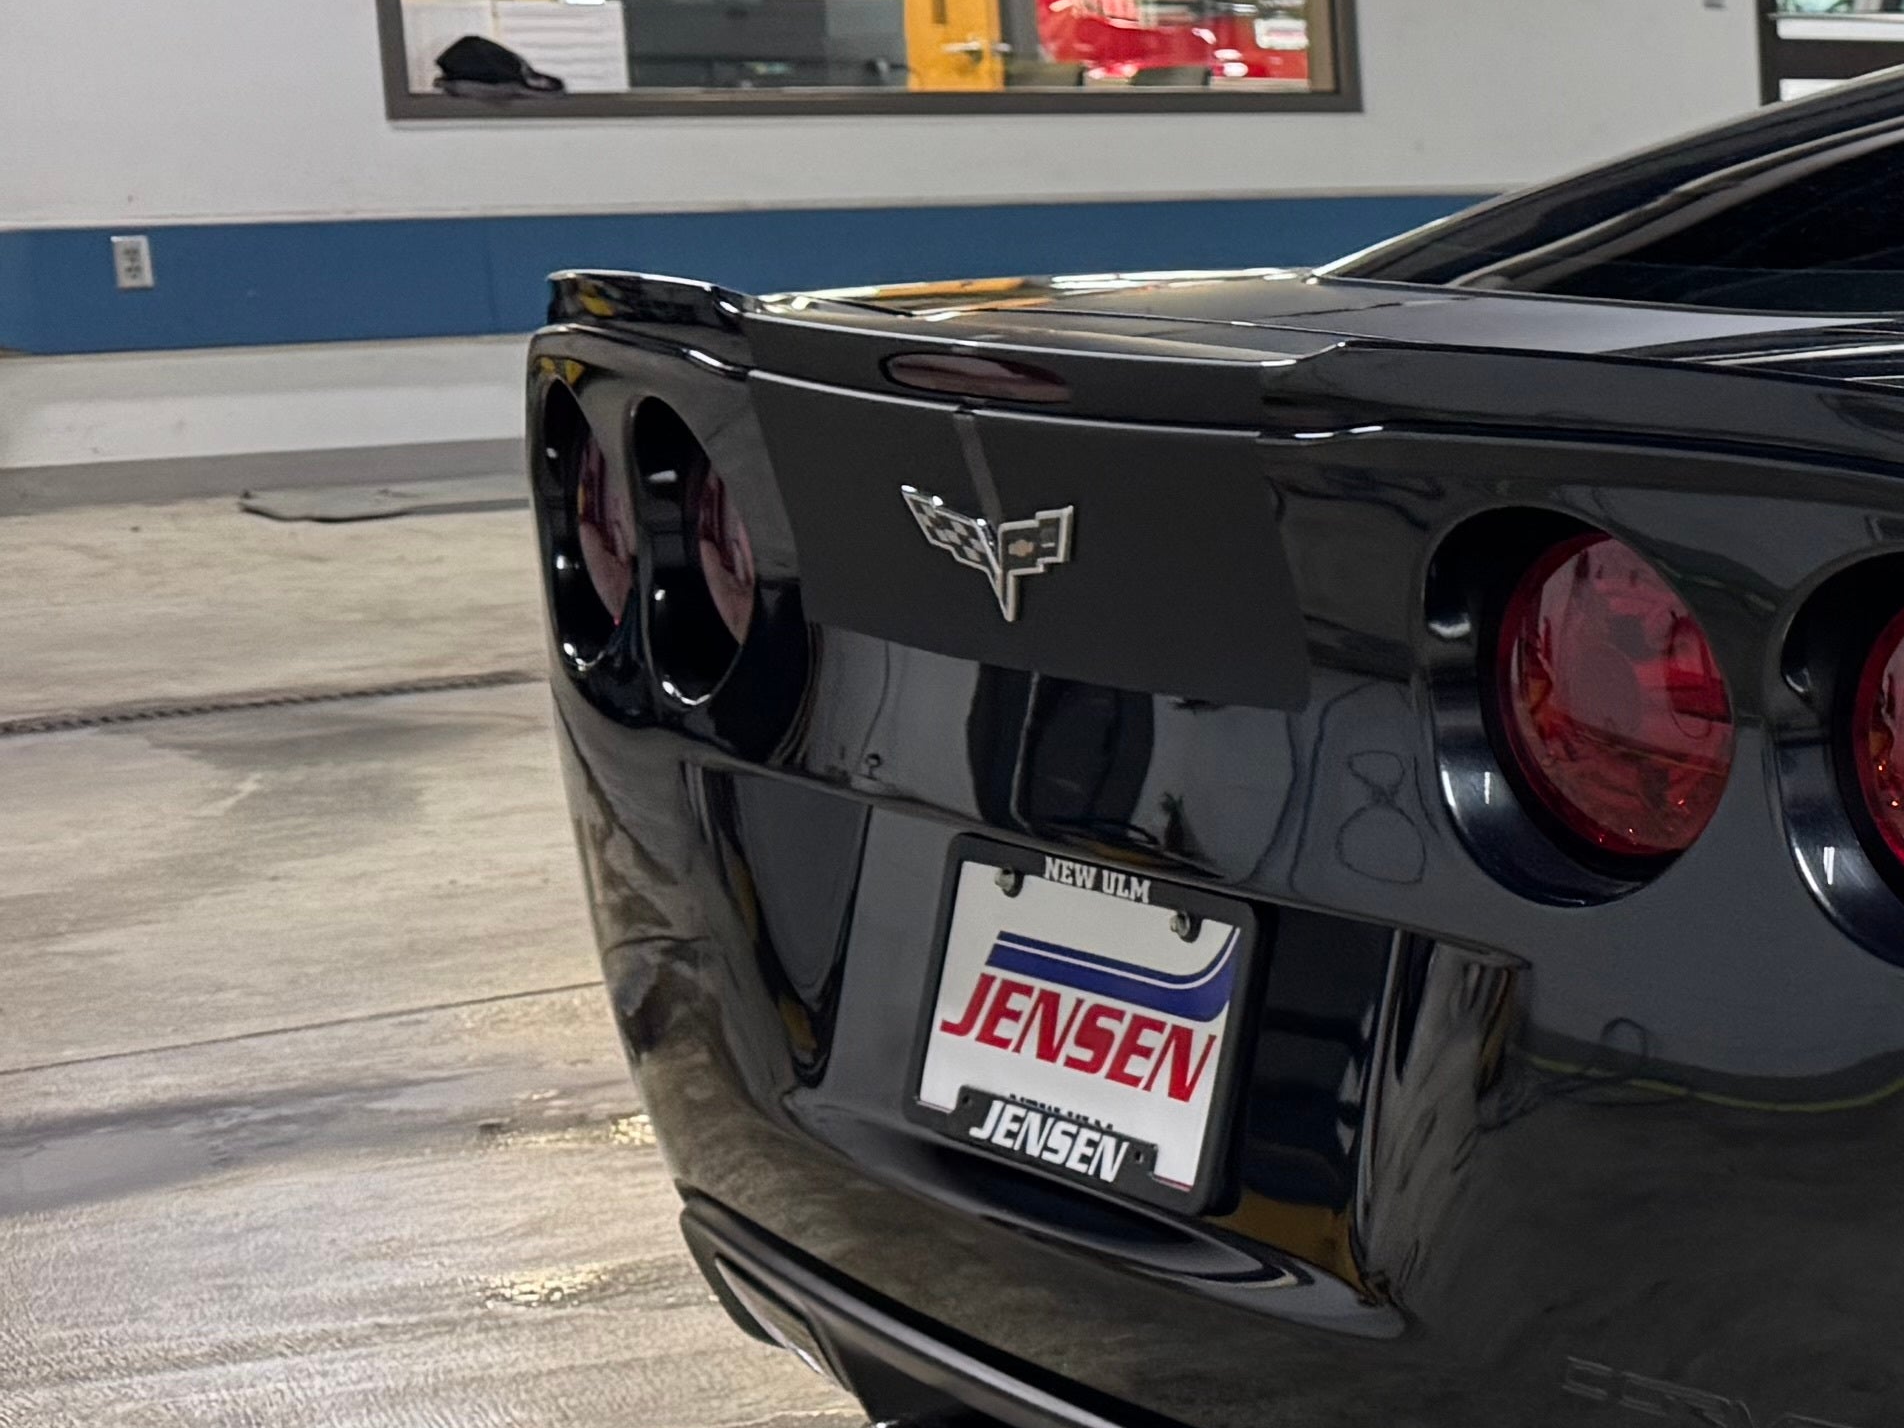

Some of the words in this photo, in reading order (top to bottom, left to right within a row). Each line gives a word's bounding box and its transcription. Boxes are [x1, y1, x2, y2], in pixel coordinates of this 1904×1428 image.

[1044, 856, 1098, 891] NEW
[1102, 871, 1151, 903] ULM
[940, 972, 1217, 1103] JENSEN
[969, 1099, 1130, 1183] JENSEN
